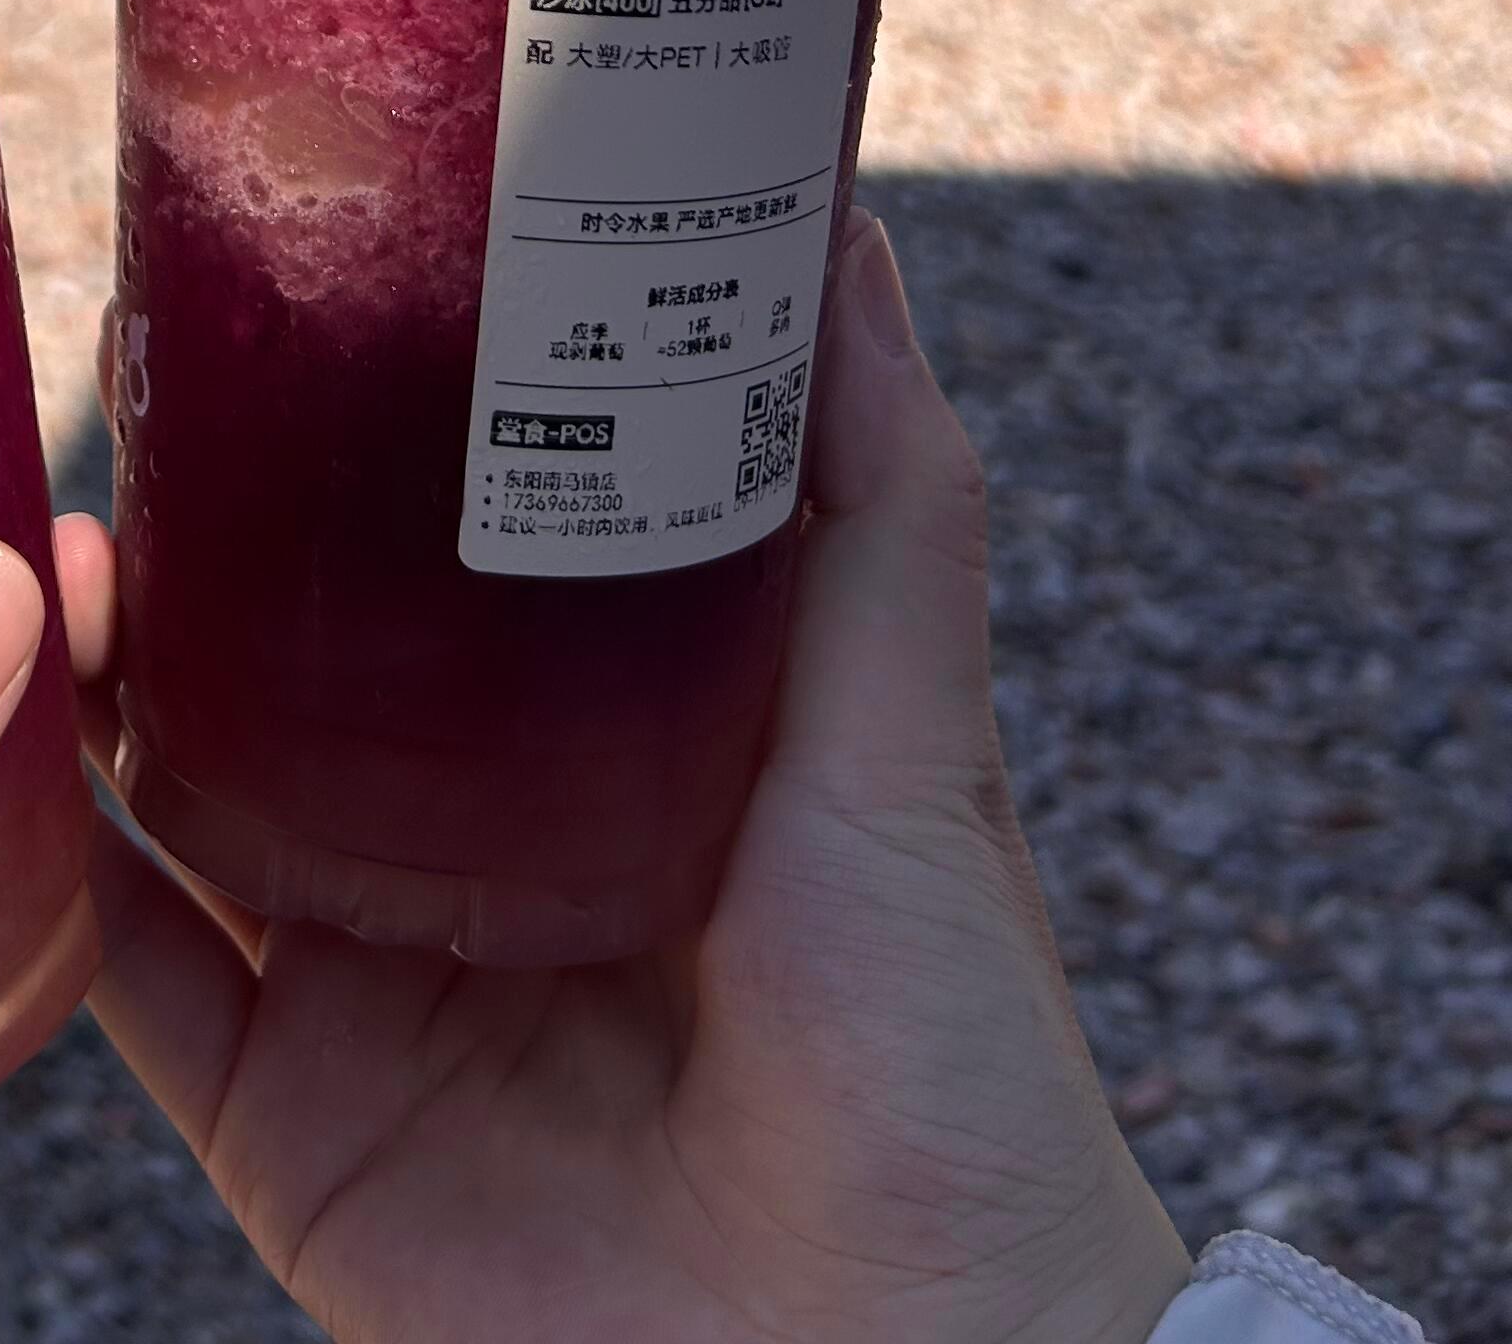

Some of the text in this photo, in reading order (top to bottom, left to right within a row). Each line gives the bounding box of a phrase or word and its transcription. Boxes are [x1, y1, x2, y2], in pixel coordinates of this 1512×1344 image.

[581, 212, 669, 234] 时令水果
[496, 417, 610, 446] 堂食-POS
[503, 493, 623, 512] 17369667300
